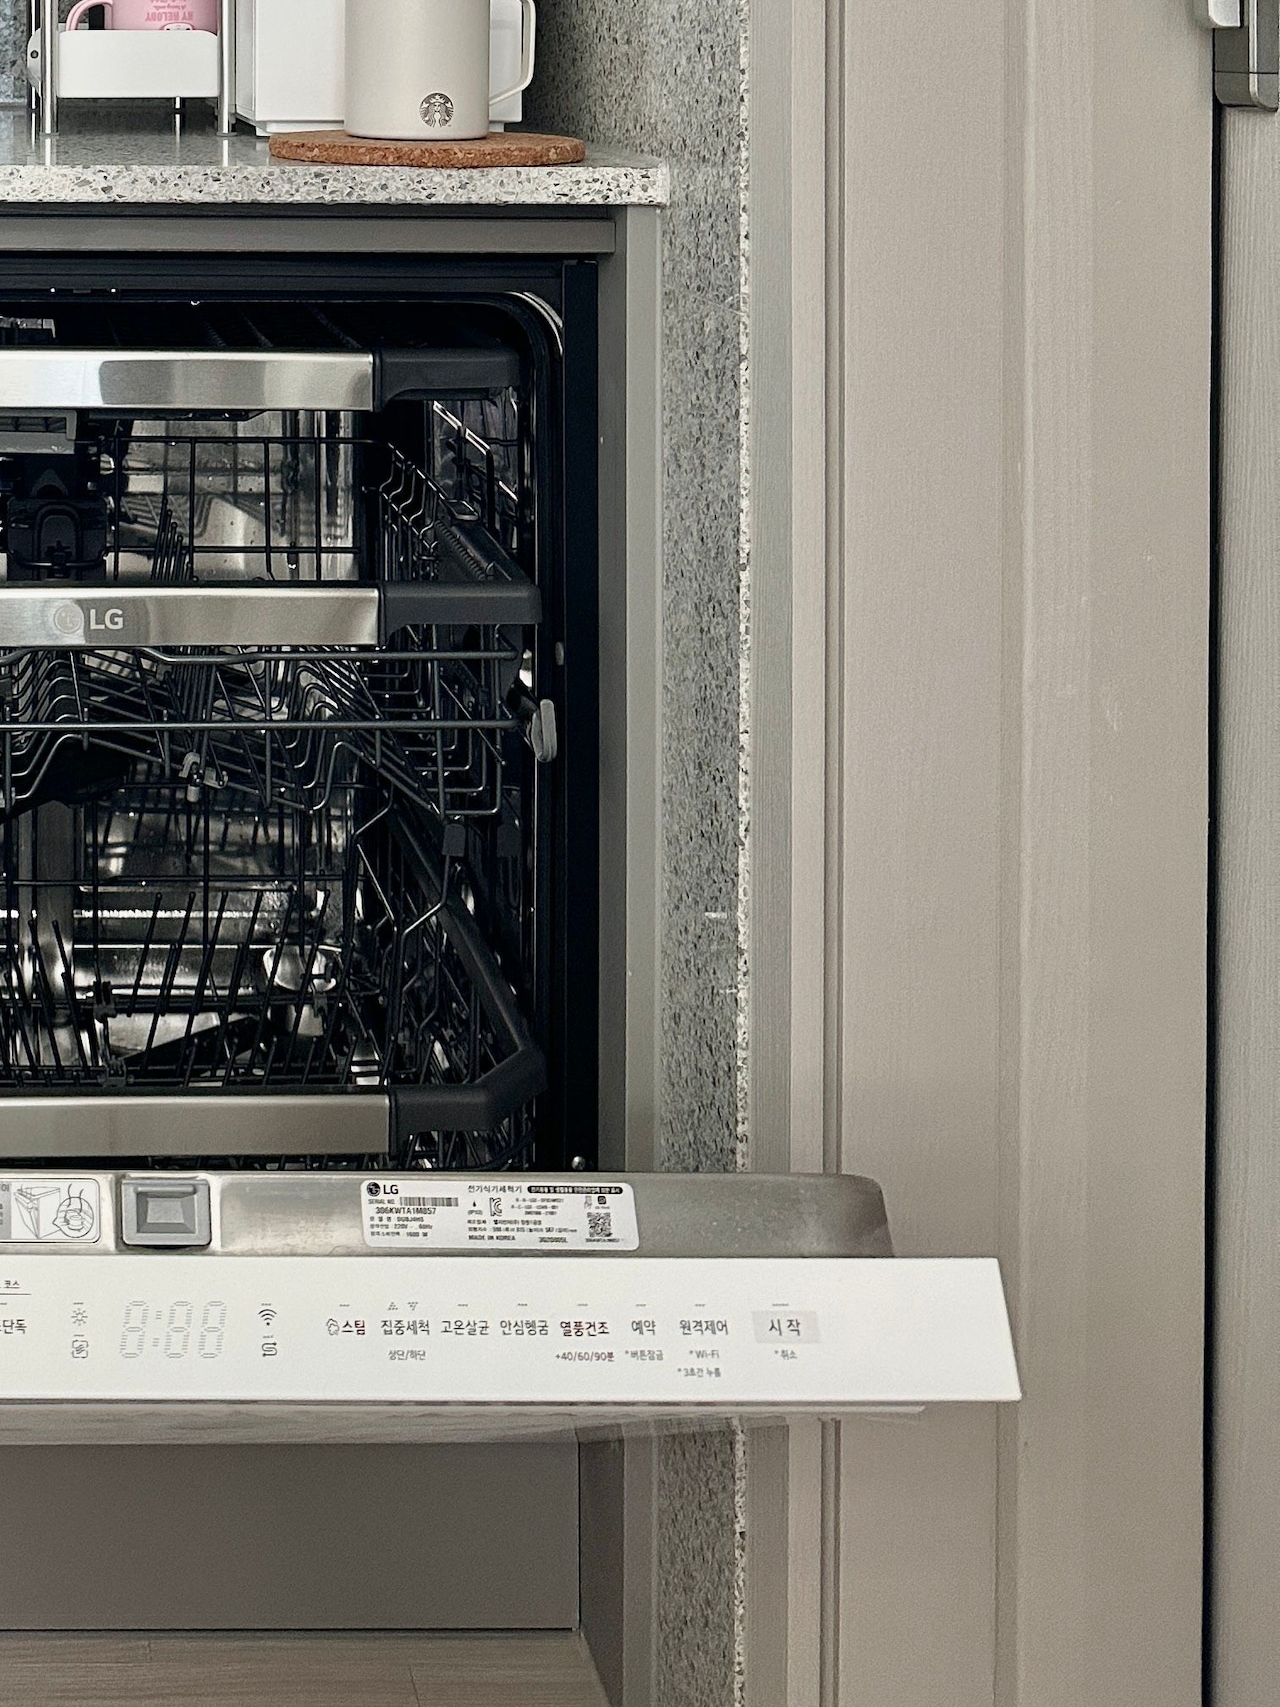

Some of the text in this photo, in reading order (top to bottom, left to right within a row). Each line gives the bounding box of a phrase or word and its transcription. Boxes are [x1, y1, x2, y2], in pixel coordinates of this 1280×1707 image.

[145, 11, 179, 21] MELODY
[90, 609, 123, 630] LG
[383, 1185, 398, 1194] LG
[4, 1280, 20, 1288] 코스
[341, 1320, 366, 1335] 스팀
[381, 1319, 430, 1335] 집중세척
[441, 1320, 489, 1335] 고온살균
[560, 1320, 610, 1336] 열풍건조
[632, 1320, 656, 1335] 예약
[679, 1320, 728, 1335] 원격제어
[388, 1350, 426, 1360] 상단/하단
[555, 1351, 615, 1361] +40/60/90분
[696, 1350, 719, 1358] Wi-Fi
